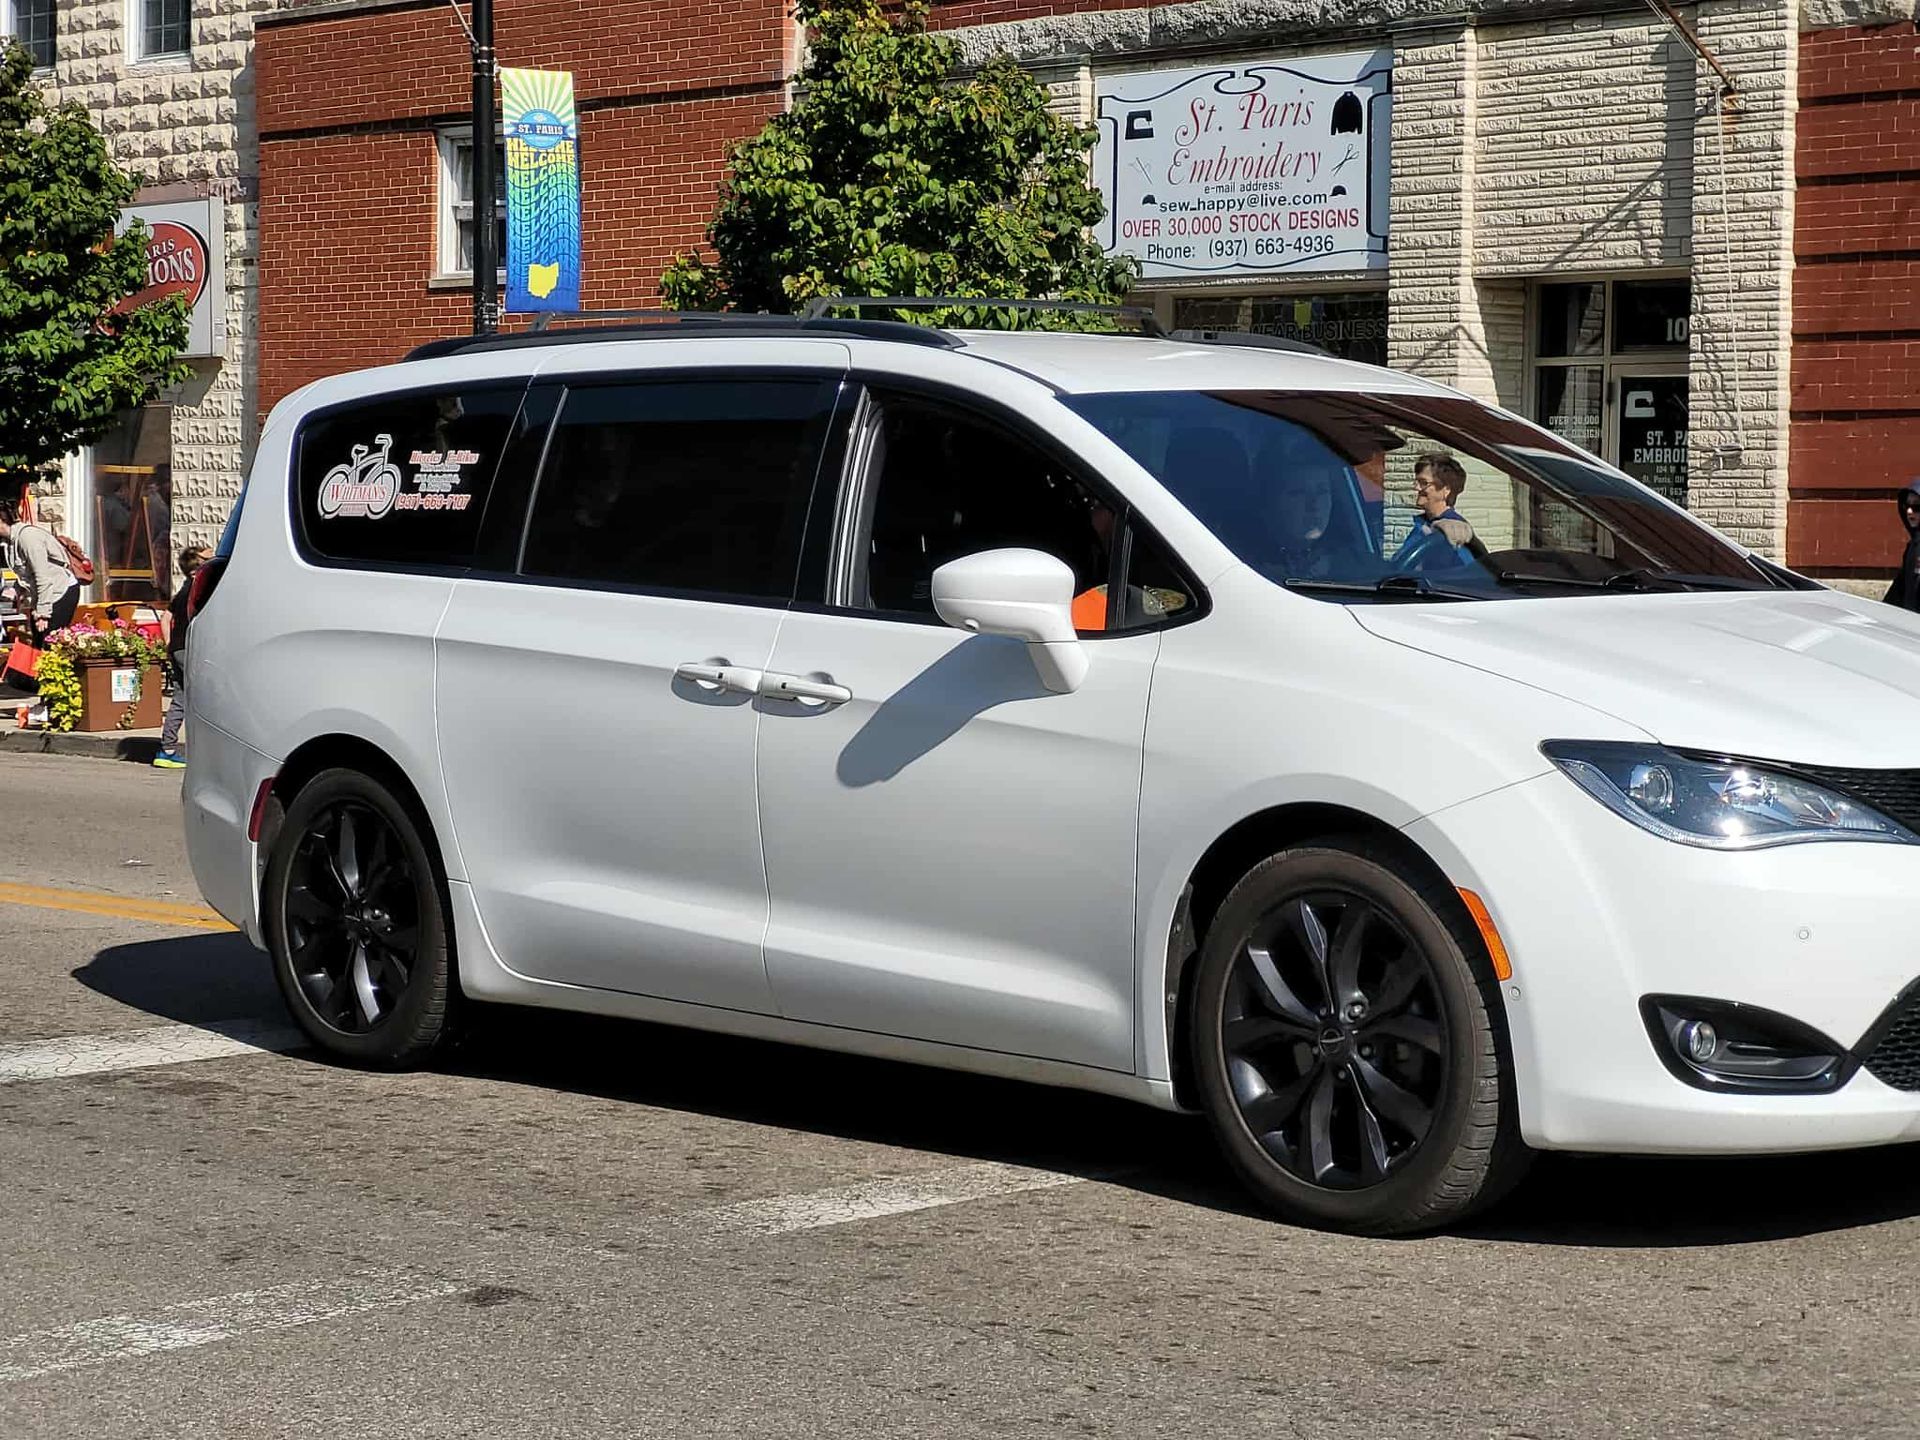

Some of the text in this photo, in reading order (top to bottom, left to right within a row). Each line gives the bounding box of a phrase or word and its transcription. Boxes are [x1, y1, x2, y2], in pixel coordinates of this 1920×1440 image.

[1174, 88, 1315, 147] St. Paris
[518, 124, 564, 135] ST. PARIS
[506, 138, 574, 152] WEME
[507, 150, 575, 170] WELCOME
[1167, 141, 1321, 186] Embroidery
[1204, 180, 1283, 194] e-mail address:
[1159, 193, 1328, 213] sew_happy@live.com
[1123, 208, 1359, 239] OVER 30,000 STOCK DESIGNS
[144, 238, 175, 260] ARIS
[1147, 234, 1334, 260] Phone: (937) 663-4936
[147, 247, 196, 287] IONS
[1303, 318, 1387, 341] BUSINESS
[1666, 317, 1688, 342] 10
[1549, 415, 1568, 425] OVER
[1646, 430, 1667, 446] ST.
[1633, 448, 1688, 463] EMBROI
[1670, 487, 1687, 496] 663-
